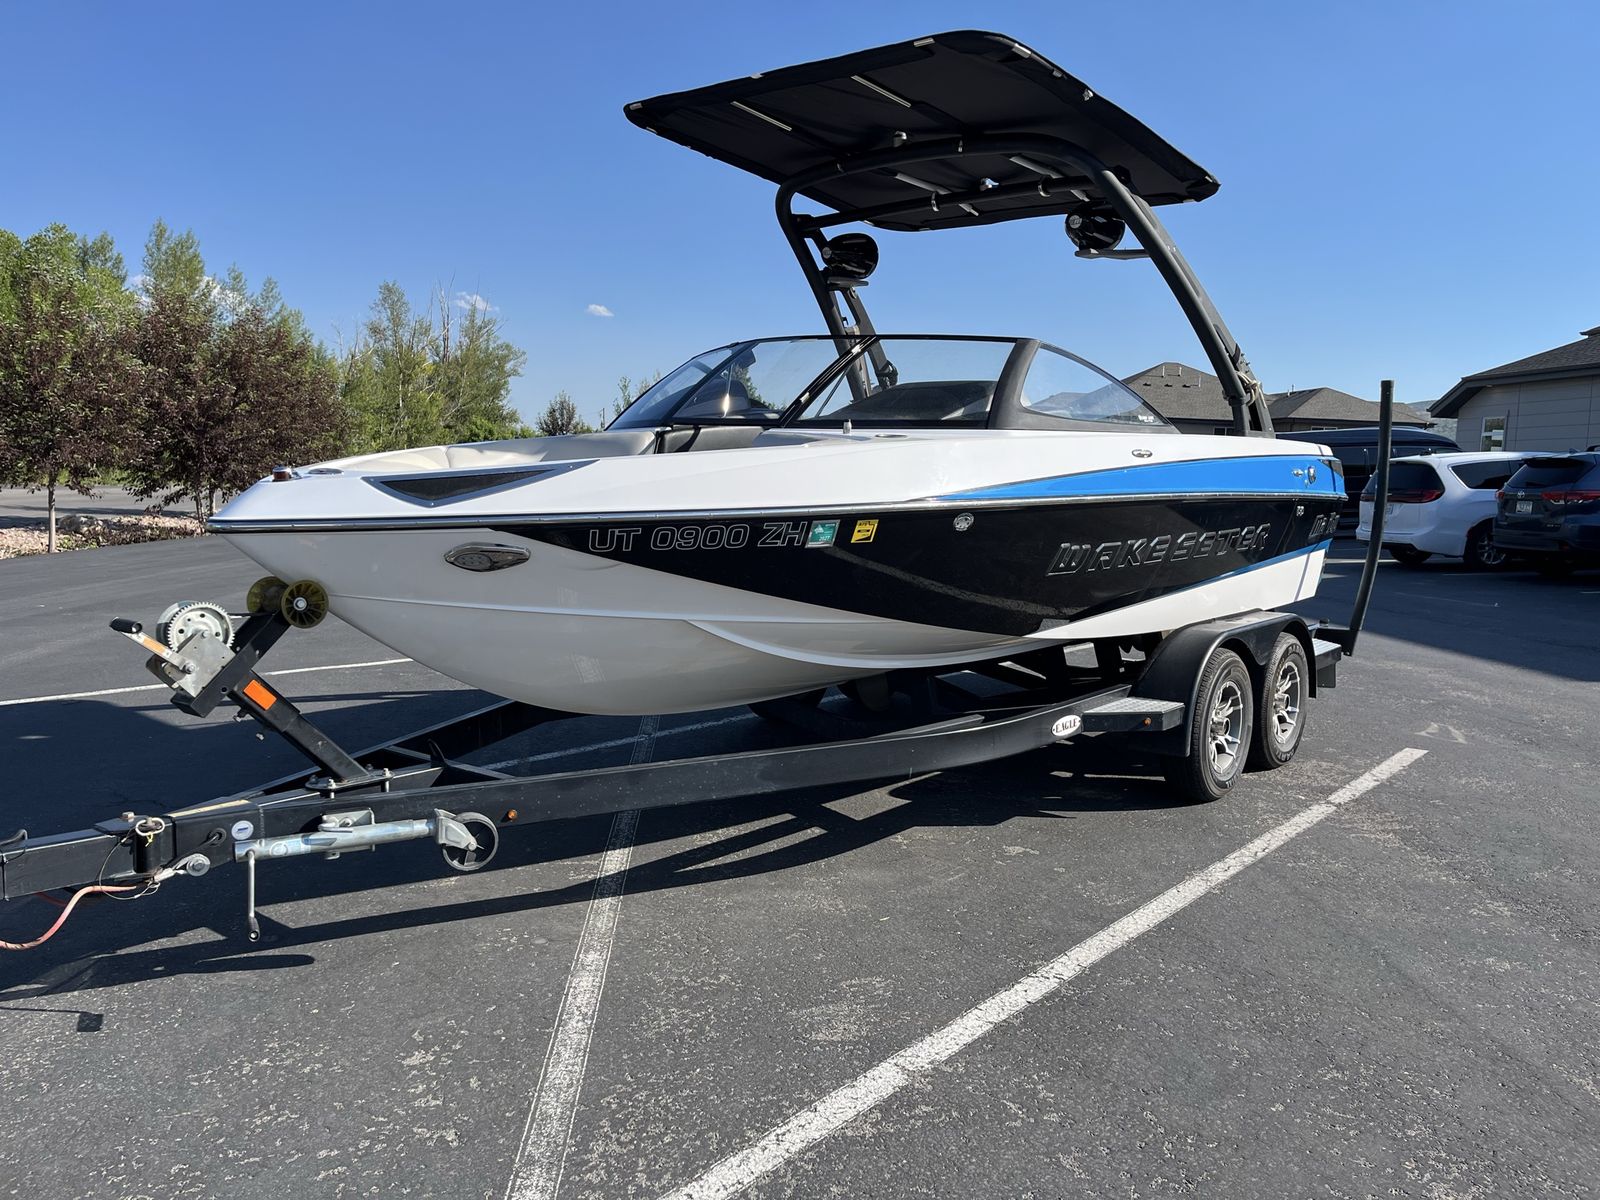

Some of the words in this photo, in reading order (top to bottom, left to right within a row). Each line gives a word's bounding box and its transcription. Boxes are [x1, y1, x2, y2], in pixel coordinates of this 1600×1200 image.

[588, 528, 641, 552] UT
[650, 523, 750, 551] 0900
[757, 521, 808, 548] ZH
[1055, 718, 1078, 733] EAGLE
